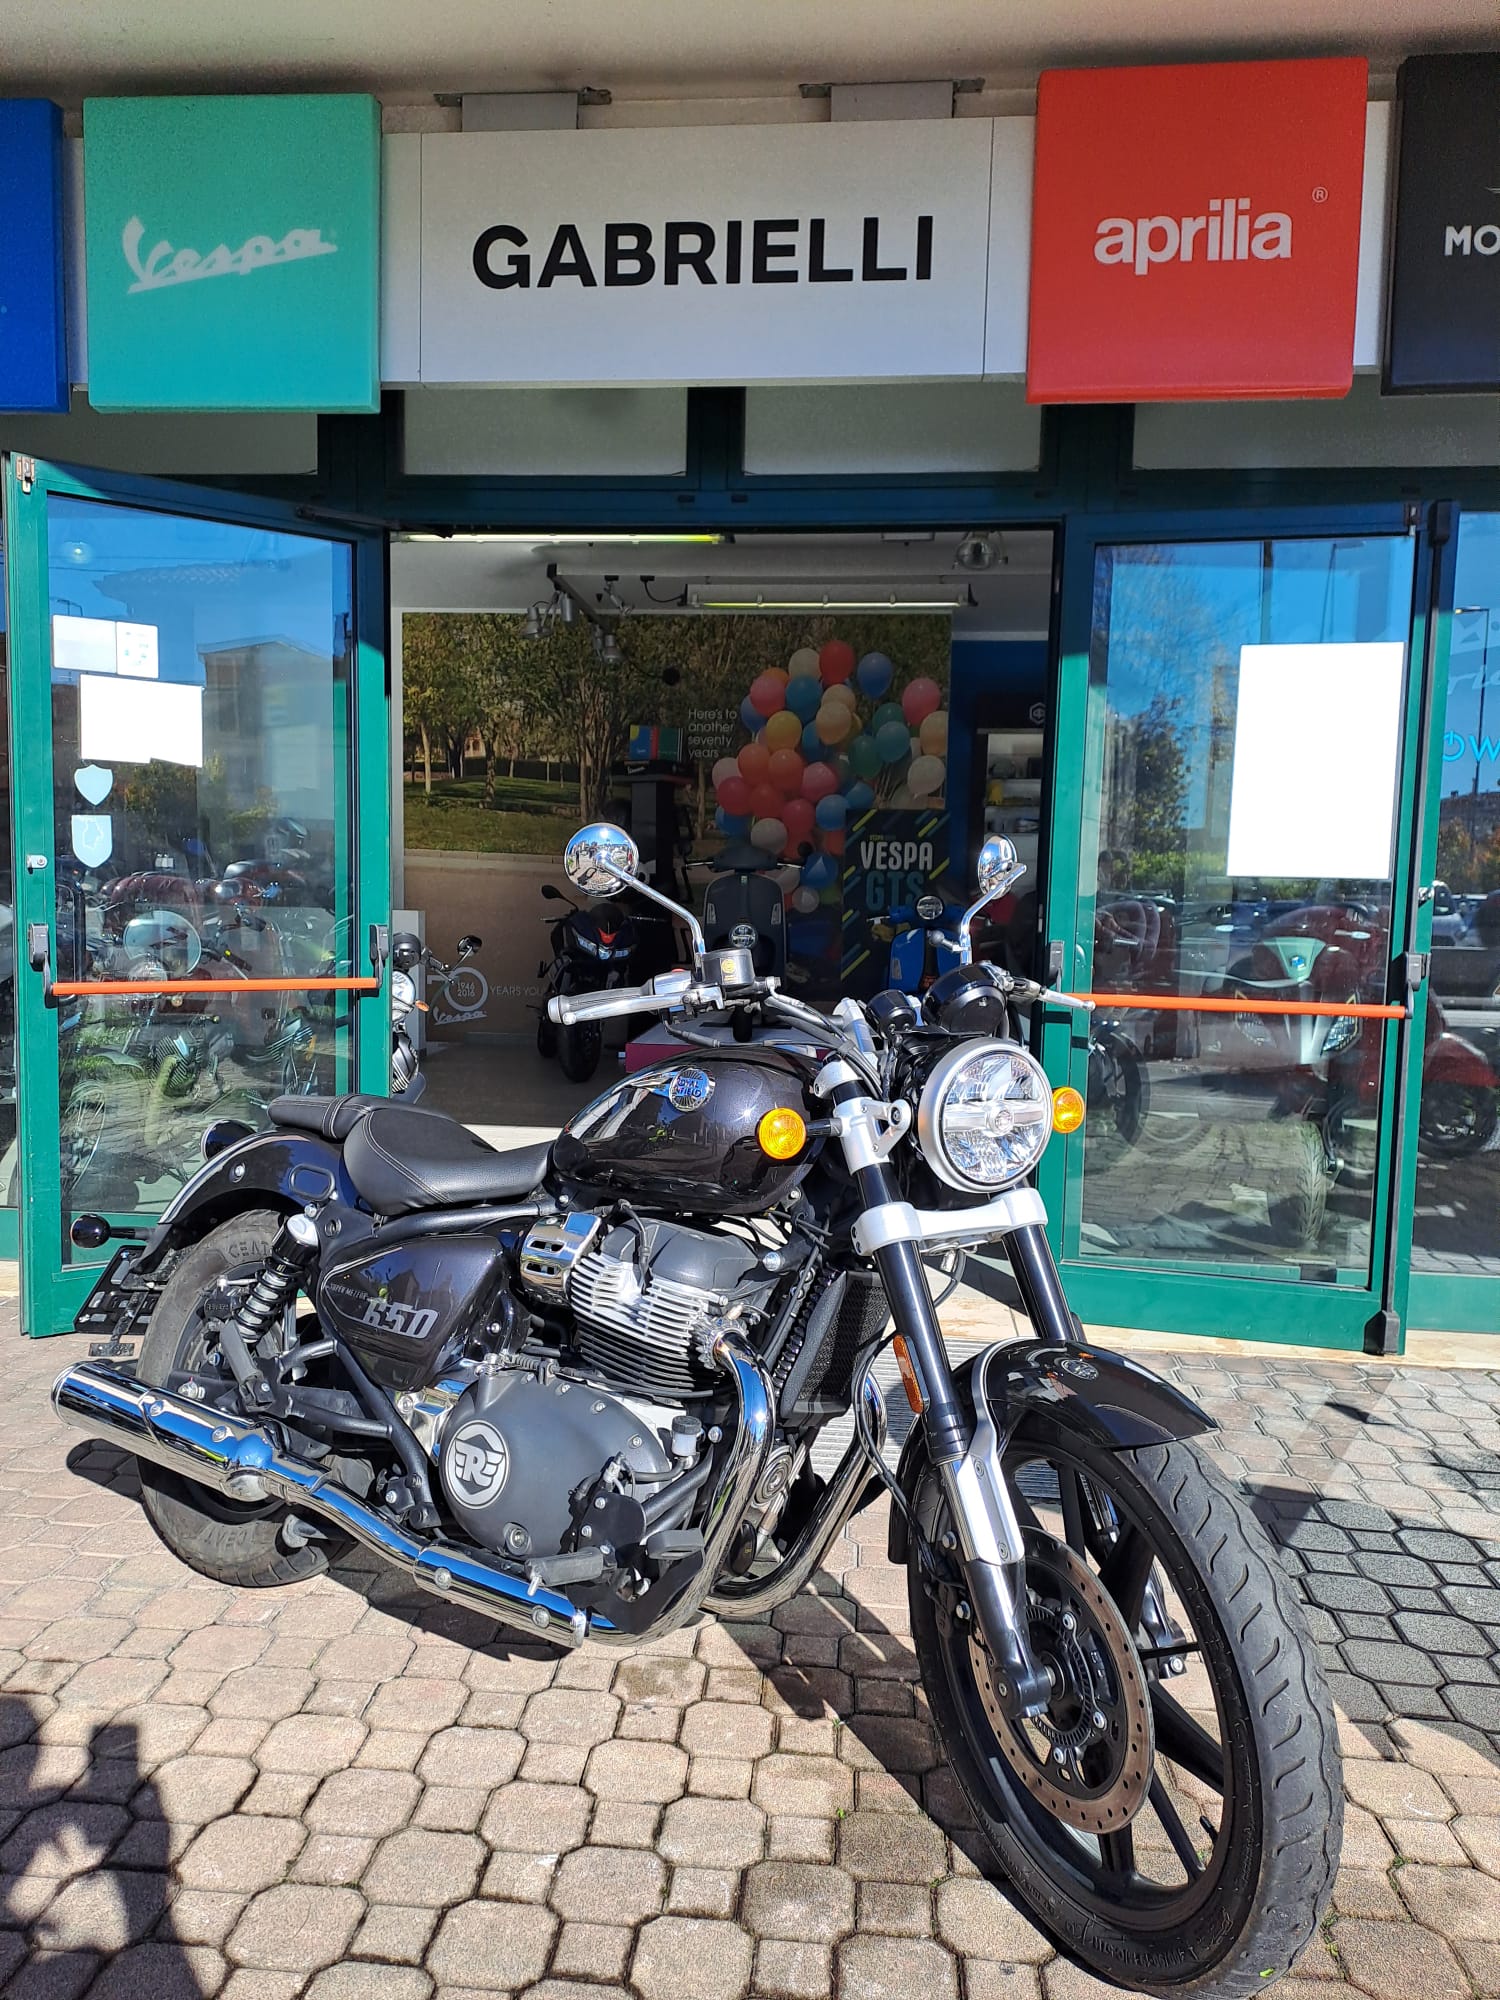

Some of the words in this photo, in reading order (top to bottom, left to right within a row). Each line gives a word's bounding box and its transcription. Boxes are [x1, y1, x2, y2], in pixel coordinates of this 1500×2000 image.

[1094, 197, 1292, 276] aprilia
[122, 215, 339, 294] Vespa
[473, 215, 933, 290] GABRIELLI
[688, 708, 723, 719] Here's
[726, 708, 737, 719] to
[688, 721, 735, 732] another
[688, 733, 733, 747] seventy
[688, 746, 719, 760] years
[860, 841, 933, 871] VESPA
[865, 870, 925, 911] GTS
[457, 989, 476, 998] 2016
[490, 985, 521, 997] YEARS
[432, 1006, 488, 1026] Vespa
[362, 1297, 439, 1339] 650
